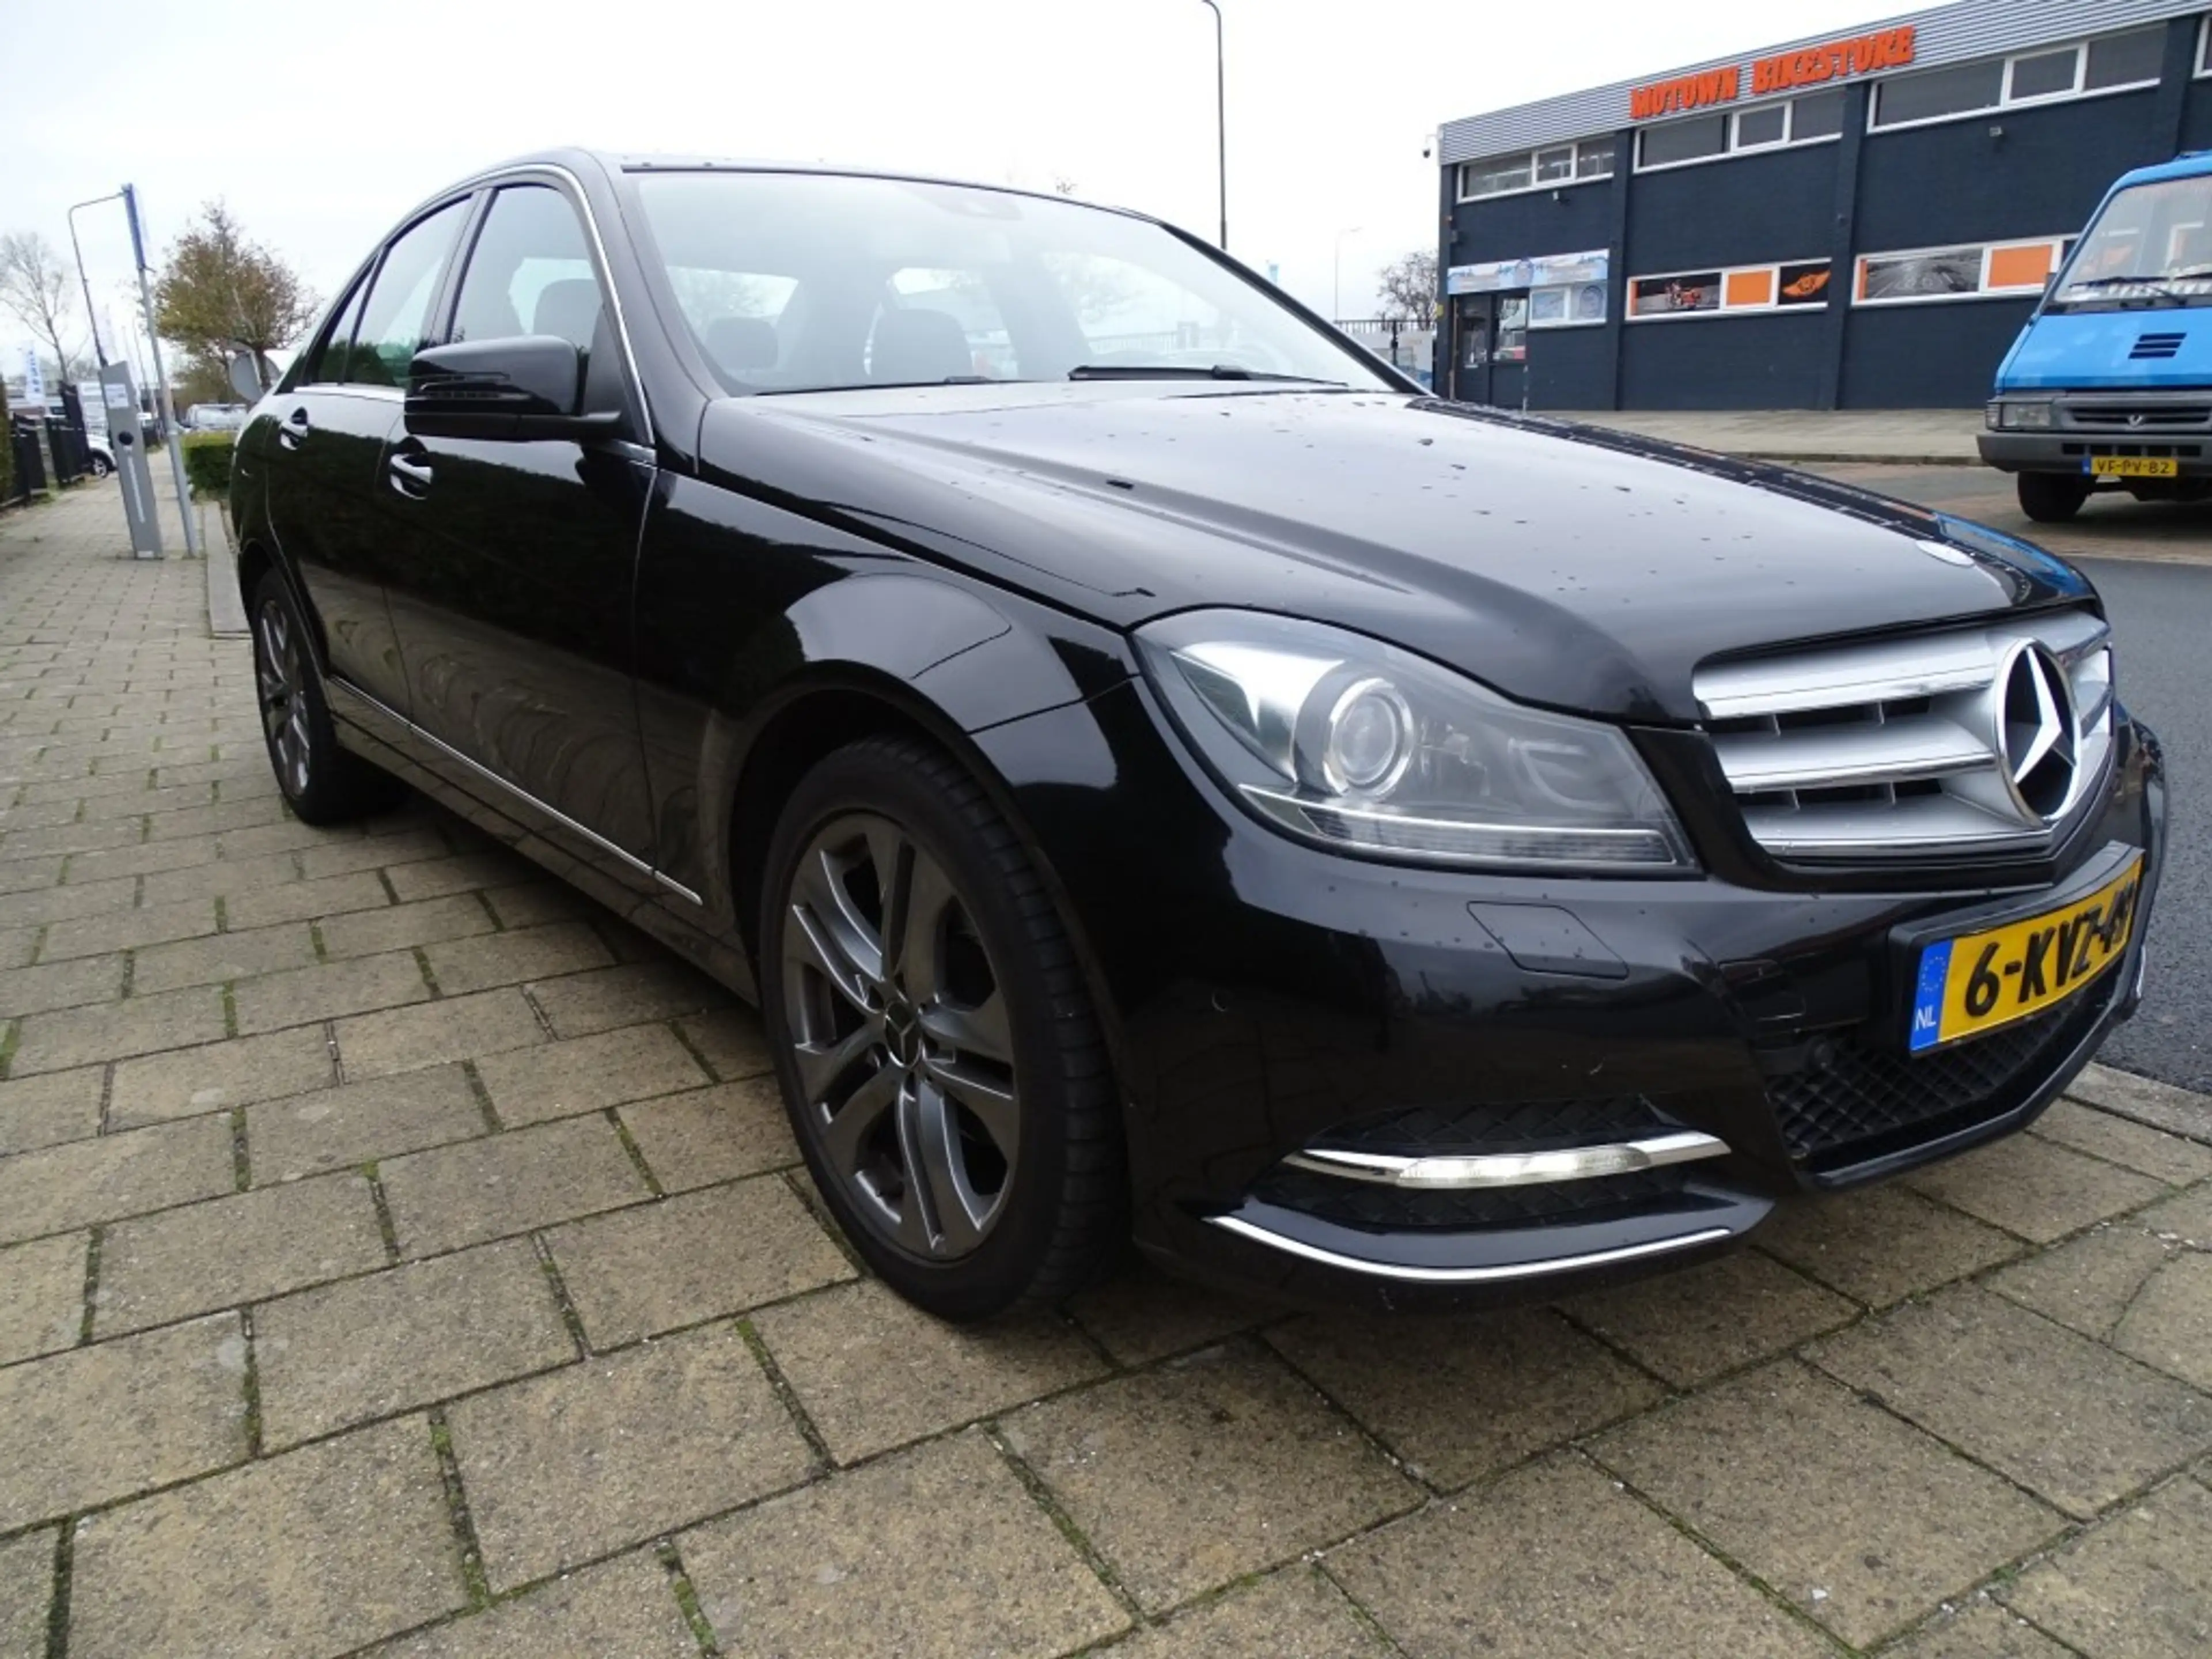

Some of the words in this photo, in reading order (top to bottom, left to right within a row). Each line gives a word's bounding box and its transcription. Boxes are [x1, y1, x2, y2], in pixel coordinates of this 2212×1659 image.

[1630, 66, 1741, 119] MOTOWN
[1751, 25, 1916, 94] BIKESTORE
[2096, 459, 2170, 474] VF-PV-82
[1915, 1005, 1937, 1032] NL
